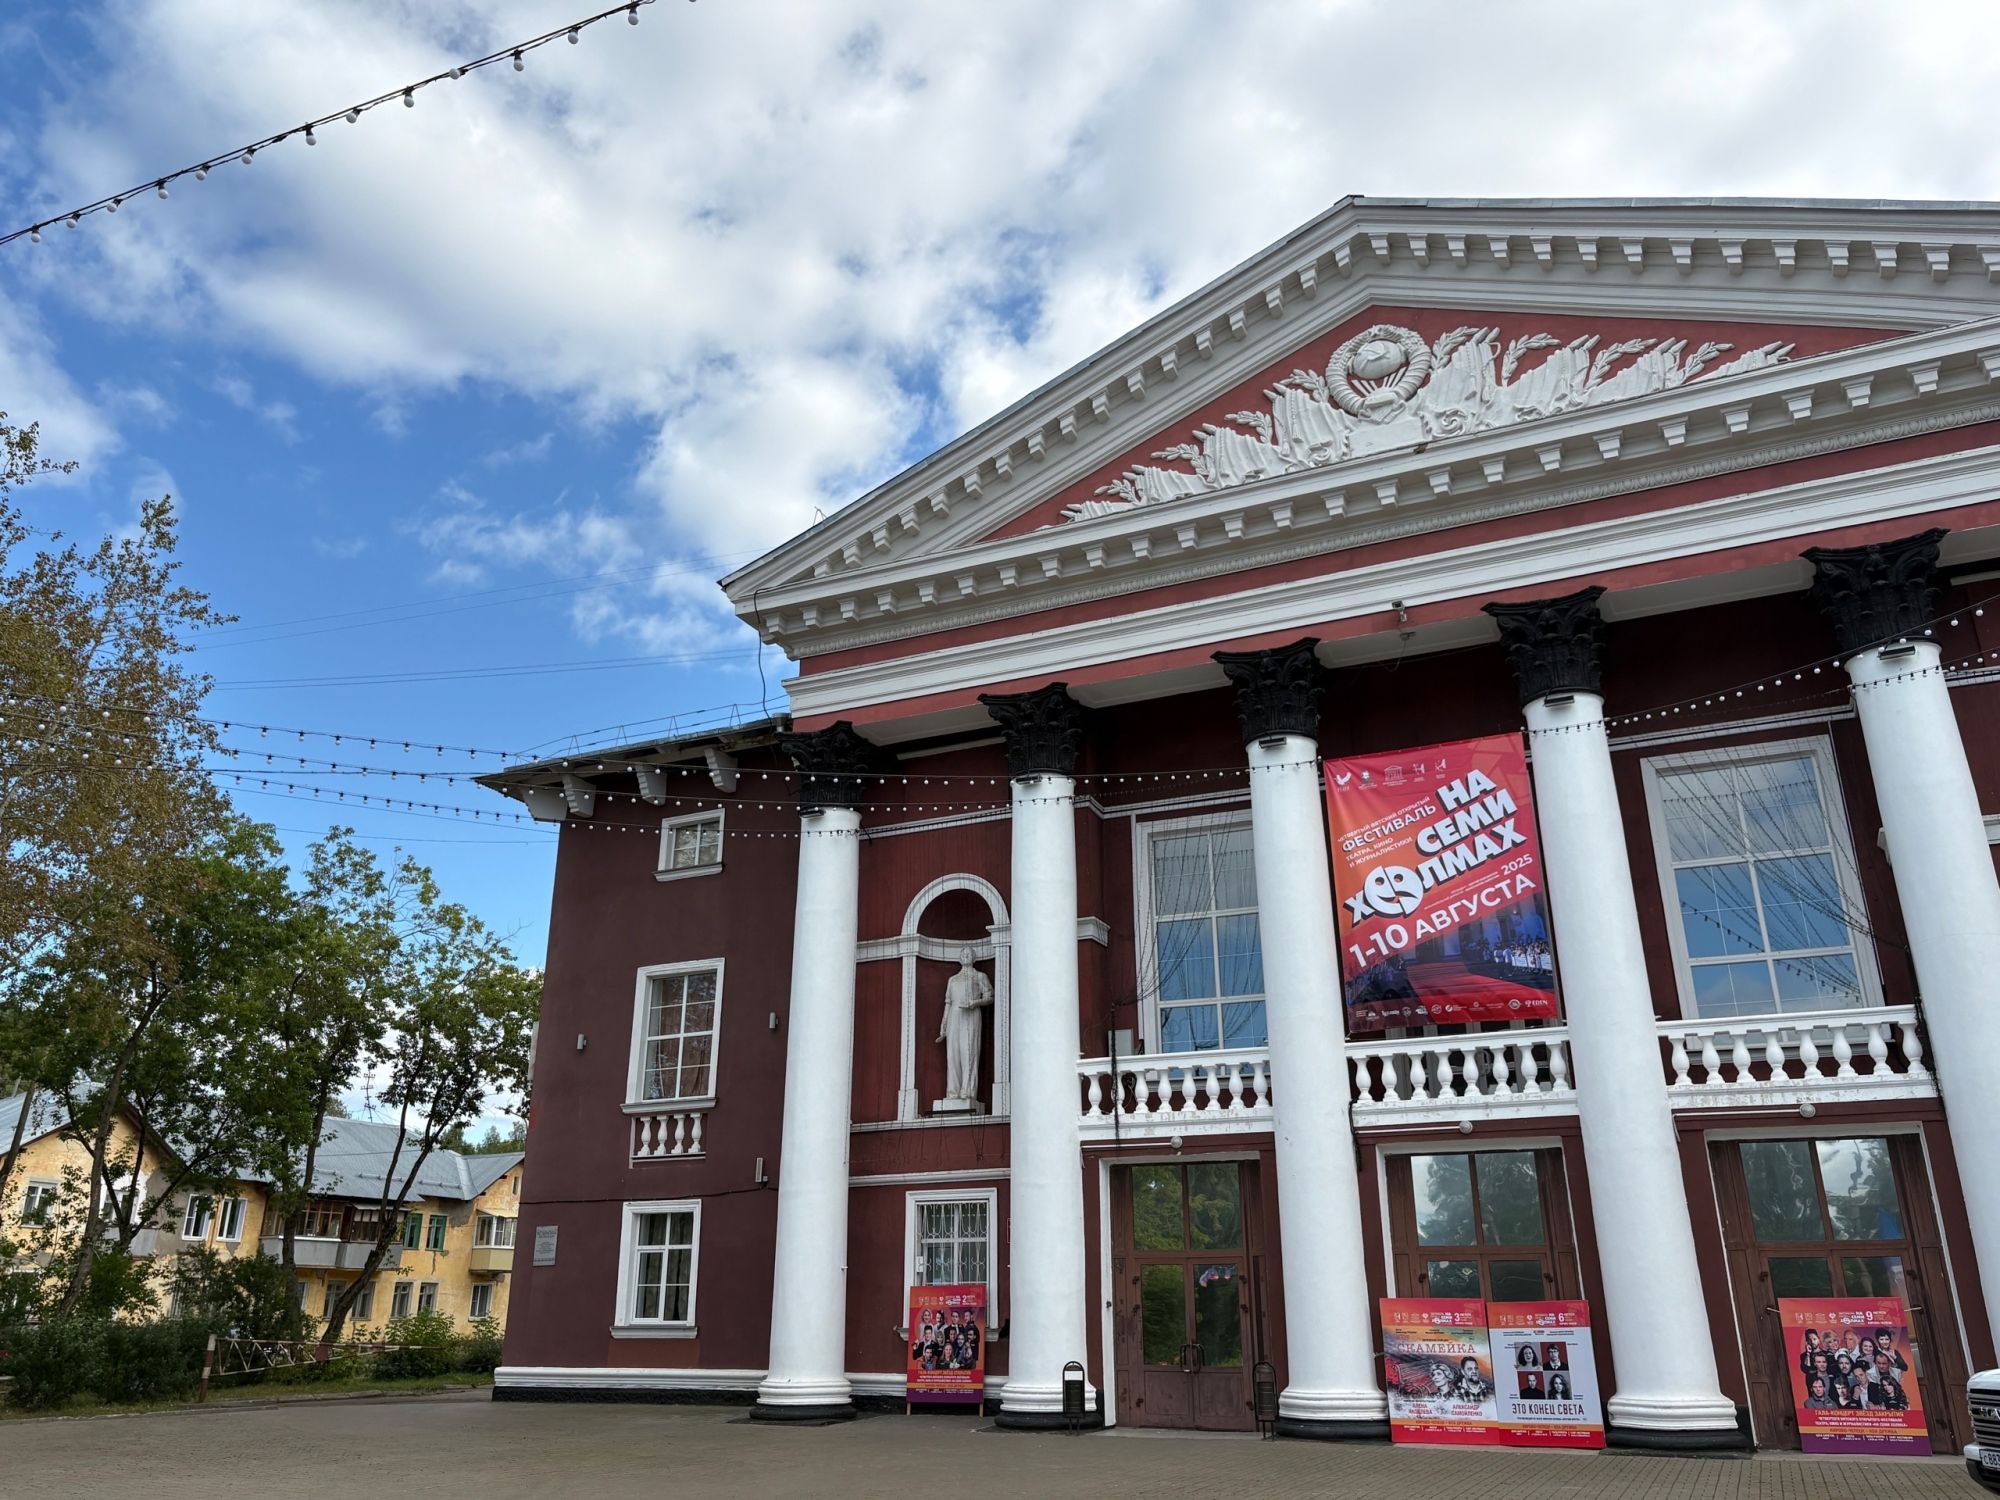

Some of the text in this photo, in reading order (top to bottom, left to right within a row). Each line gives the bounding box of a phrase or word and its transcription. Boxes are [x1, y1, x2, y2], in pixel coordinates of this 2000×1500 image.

[1437, 769, 1496, 812] НА
[1397, 796, 1430, 815] ОТКРЫТЫЙ
[1342, 804, 1437, 852] ФЕСТИВАЛЬ
[1416, 788, 1518, 853] СЕМИ
[1355, 837, 1413, 864] ЖУРНАЛИСТИКИ
[1373, 837, 1393, 849] КИНО
[1343, 818, 1527, 923] ХОЛМАХ
[1501, 853, 1533, 875] 2025
[1349, 924, 1409, 968] 1-10
[1415, 874, 1536, 939] АВГУСТА
[1454, 1312, 1460, 1321] 3
[1558, 1312, 1565, 1322] 6
[1865, 1310, 1873, 1321] 9
[1397, 1341, 1477, 1354] СКАМЕЙКА
[1512, 1403, 1585, 1415] ЭТО КОНЕЦ СВЕТА
